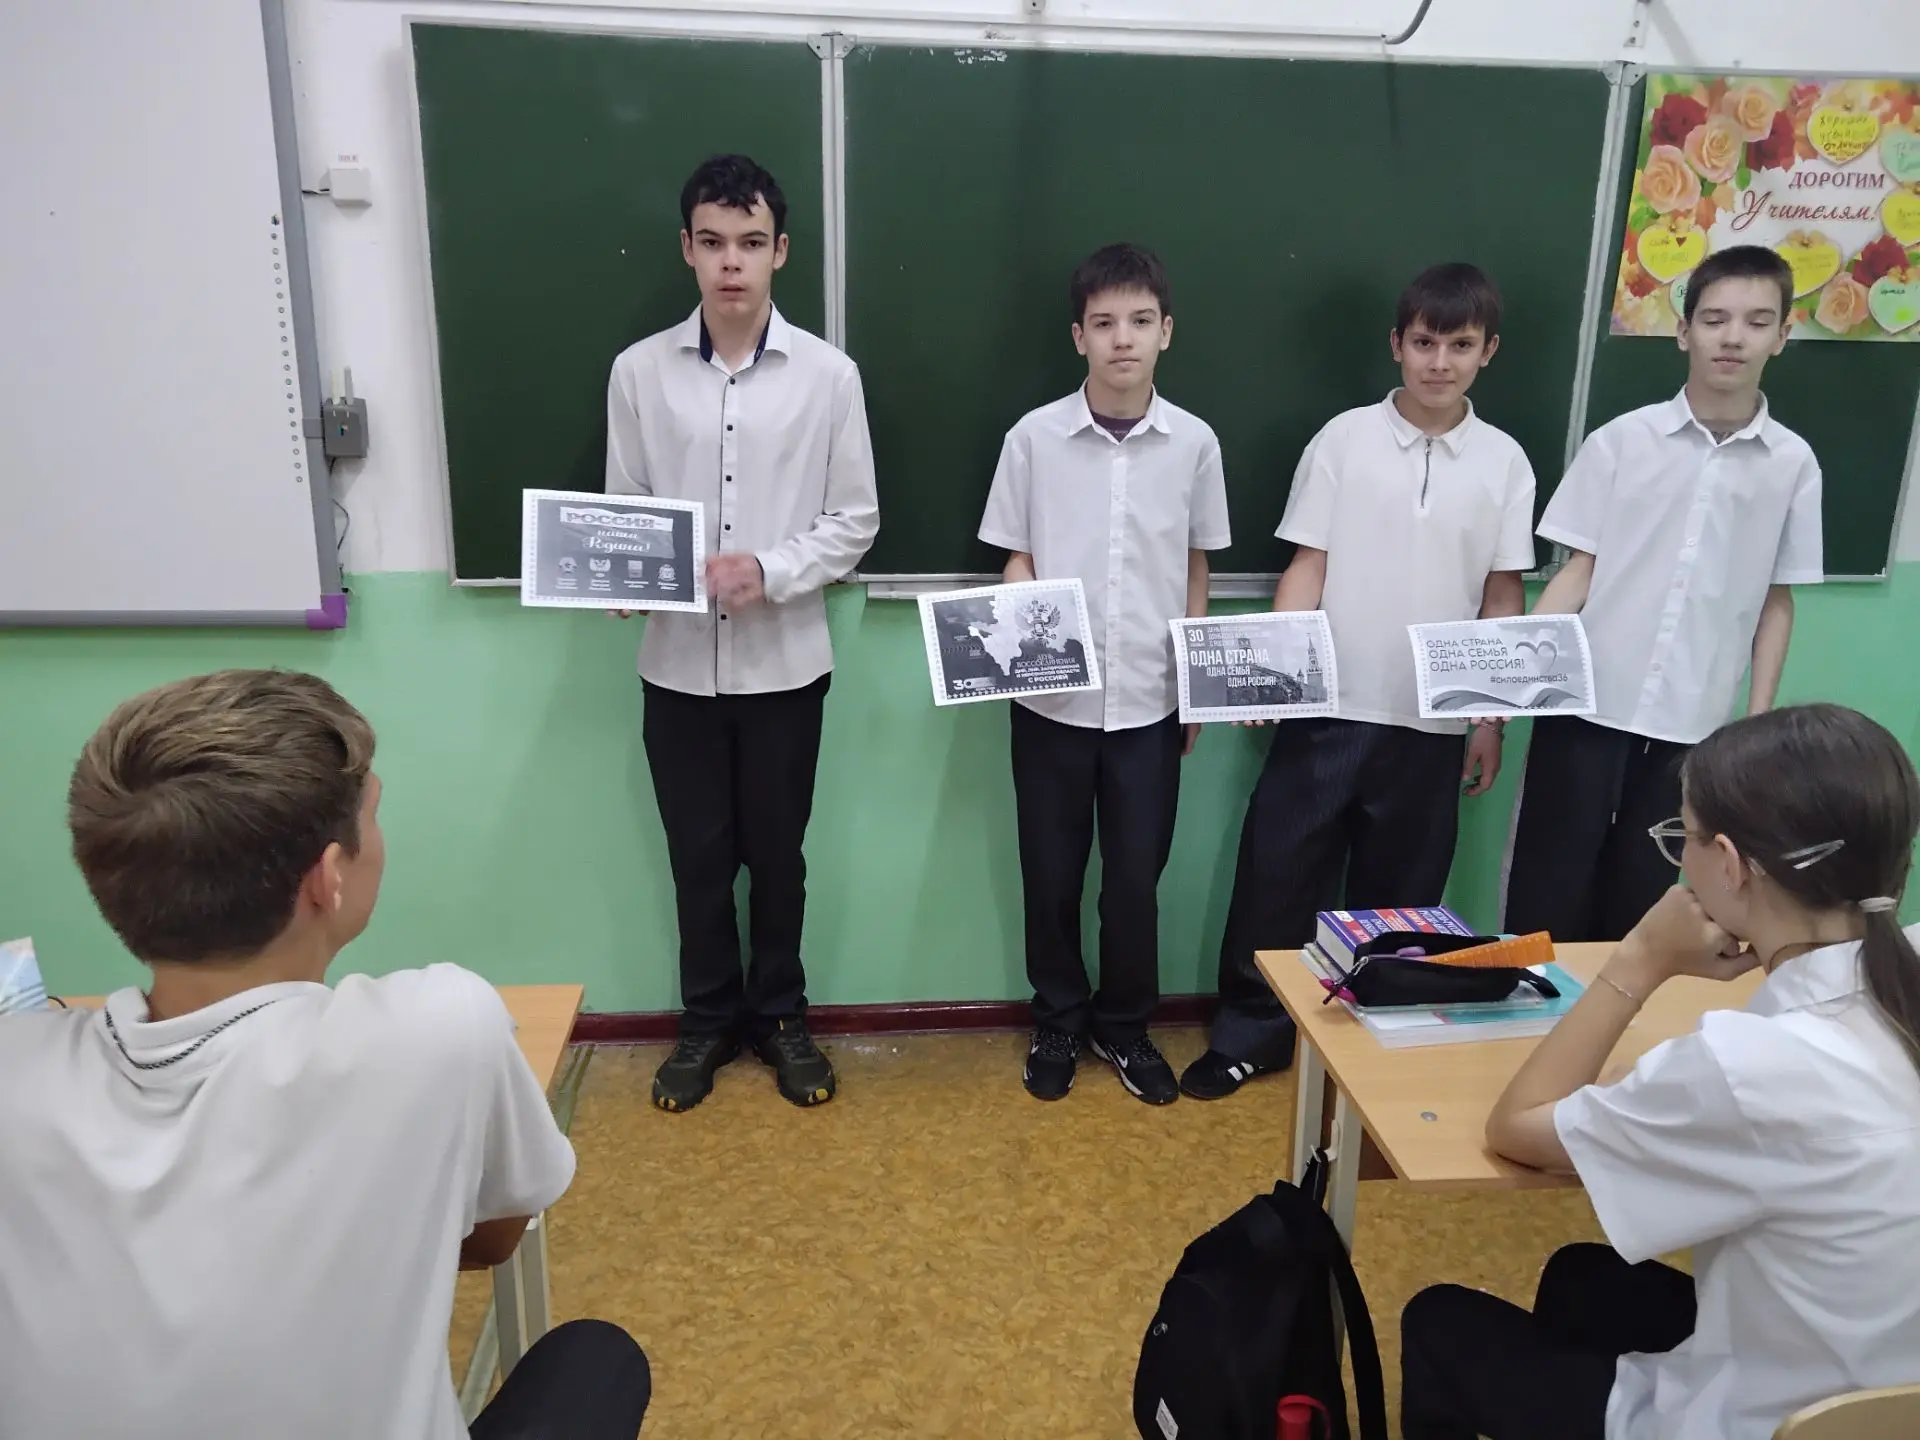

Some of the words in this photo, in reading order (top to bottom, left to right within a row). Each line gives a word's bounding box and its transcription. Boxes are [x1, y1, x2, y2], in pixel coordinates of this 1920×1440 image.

[1788, 171, 1886, 190] ДОРОГИМ
[1188, 629, 1204, 642] 30
[1427, 640, 1459, 648] ОДНА
[1461, 638, 1503, 647] СТРАНА
[1190, 650, 1224, 667] ОДНА
[1225, 648, 1270, 665] СТРАНА
[1428, 649, 1464, 659] ОДНА
[1468, 647, 1508, 658] СЕМЬЯ
[1206, 667, 1226, 677] ОДНА
[1227, 665, 1250, 675] СЕМЬЯ
[1430, 660, 1467, 672] ОДНА
[1470, 658, 1525, 671] РОССИЯ!
[1227, 677, 1247, 687] ОДНА
[1247, 675, 1276, 687] РОССИЯ!
